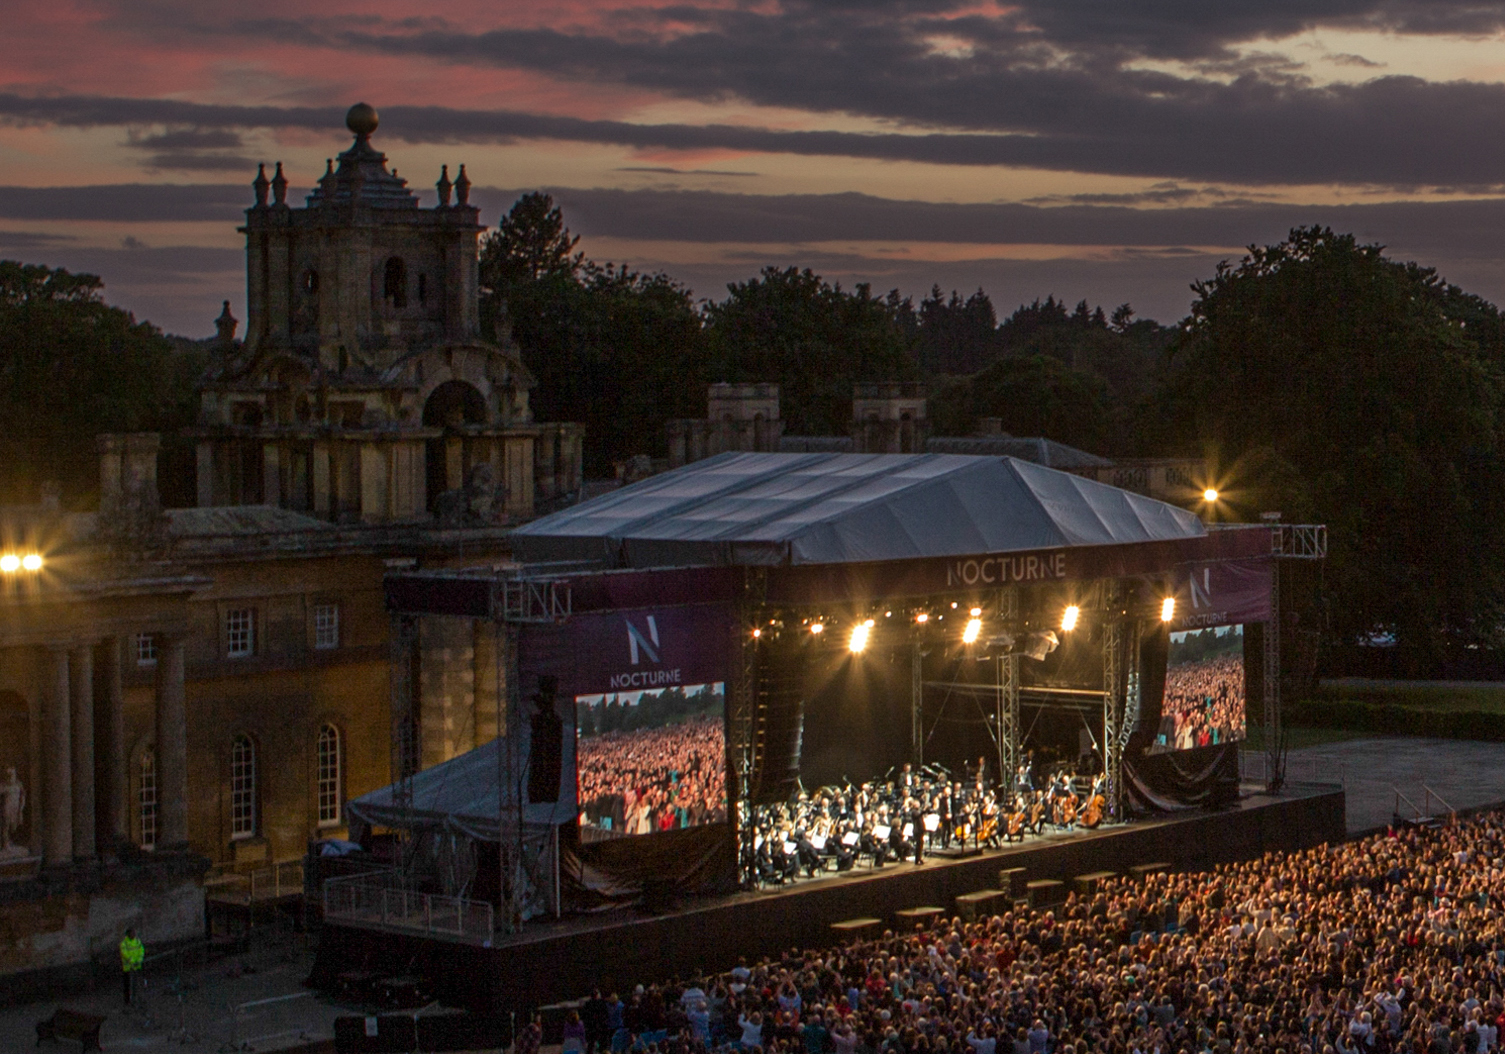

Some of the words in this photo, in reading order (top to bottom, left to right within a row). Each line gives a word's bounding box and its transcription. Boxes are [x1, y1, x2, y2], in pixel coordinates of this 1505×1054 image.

[947, 553, 1066, 586] NOCTURNE
[1190, 567, 1212, 609] N
[1182, 611, 1228, 627] NOCTURNE
[625, 615, 661, 665] N
[610, 668, 681, 688] NOCTURNE
